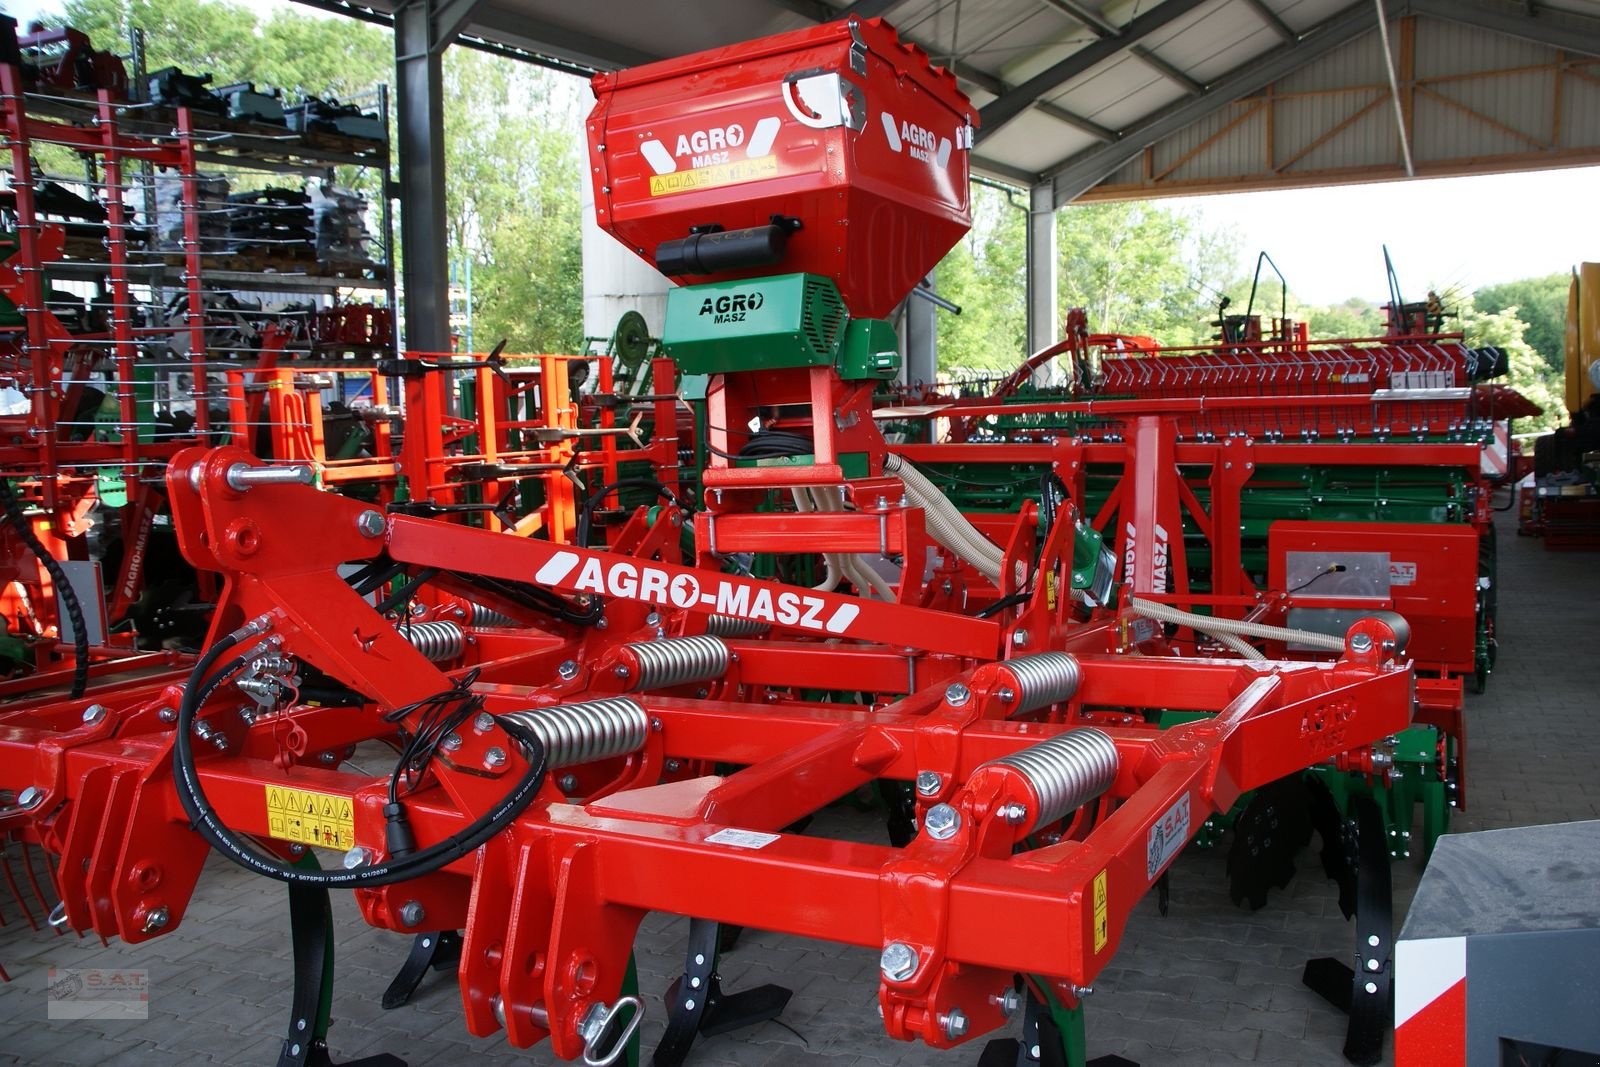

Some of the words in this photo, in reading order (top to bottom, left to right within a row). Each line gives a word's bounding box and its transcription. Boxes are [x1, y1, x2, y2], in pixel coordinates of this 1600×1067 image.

[675, 124, 745, 157] AGRO
[901, 120, 936, 152] AGRO
[692, 151, 730, 169] MASZ
[910, 145, 930, 164] MASZ
[699, 292, 764, 315] AGRO
[714, 312, 746, 324] MASZ
[127, 518, 149, 589] AGRO-MASZ
[1153, 542, 1168, 594] MASZ
[575, 557, 825, 629] AGRO-MASZ
